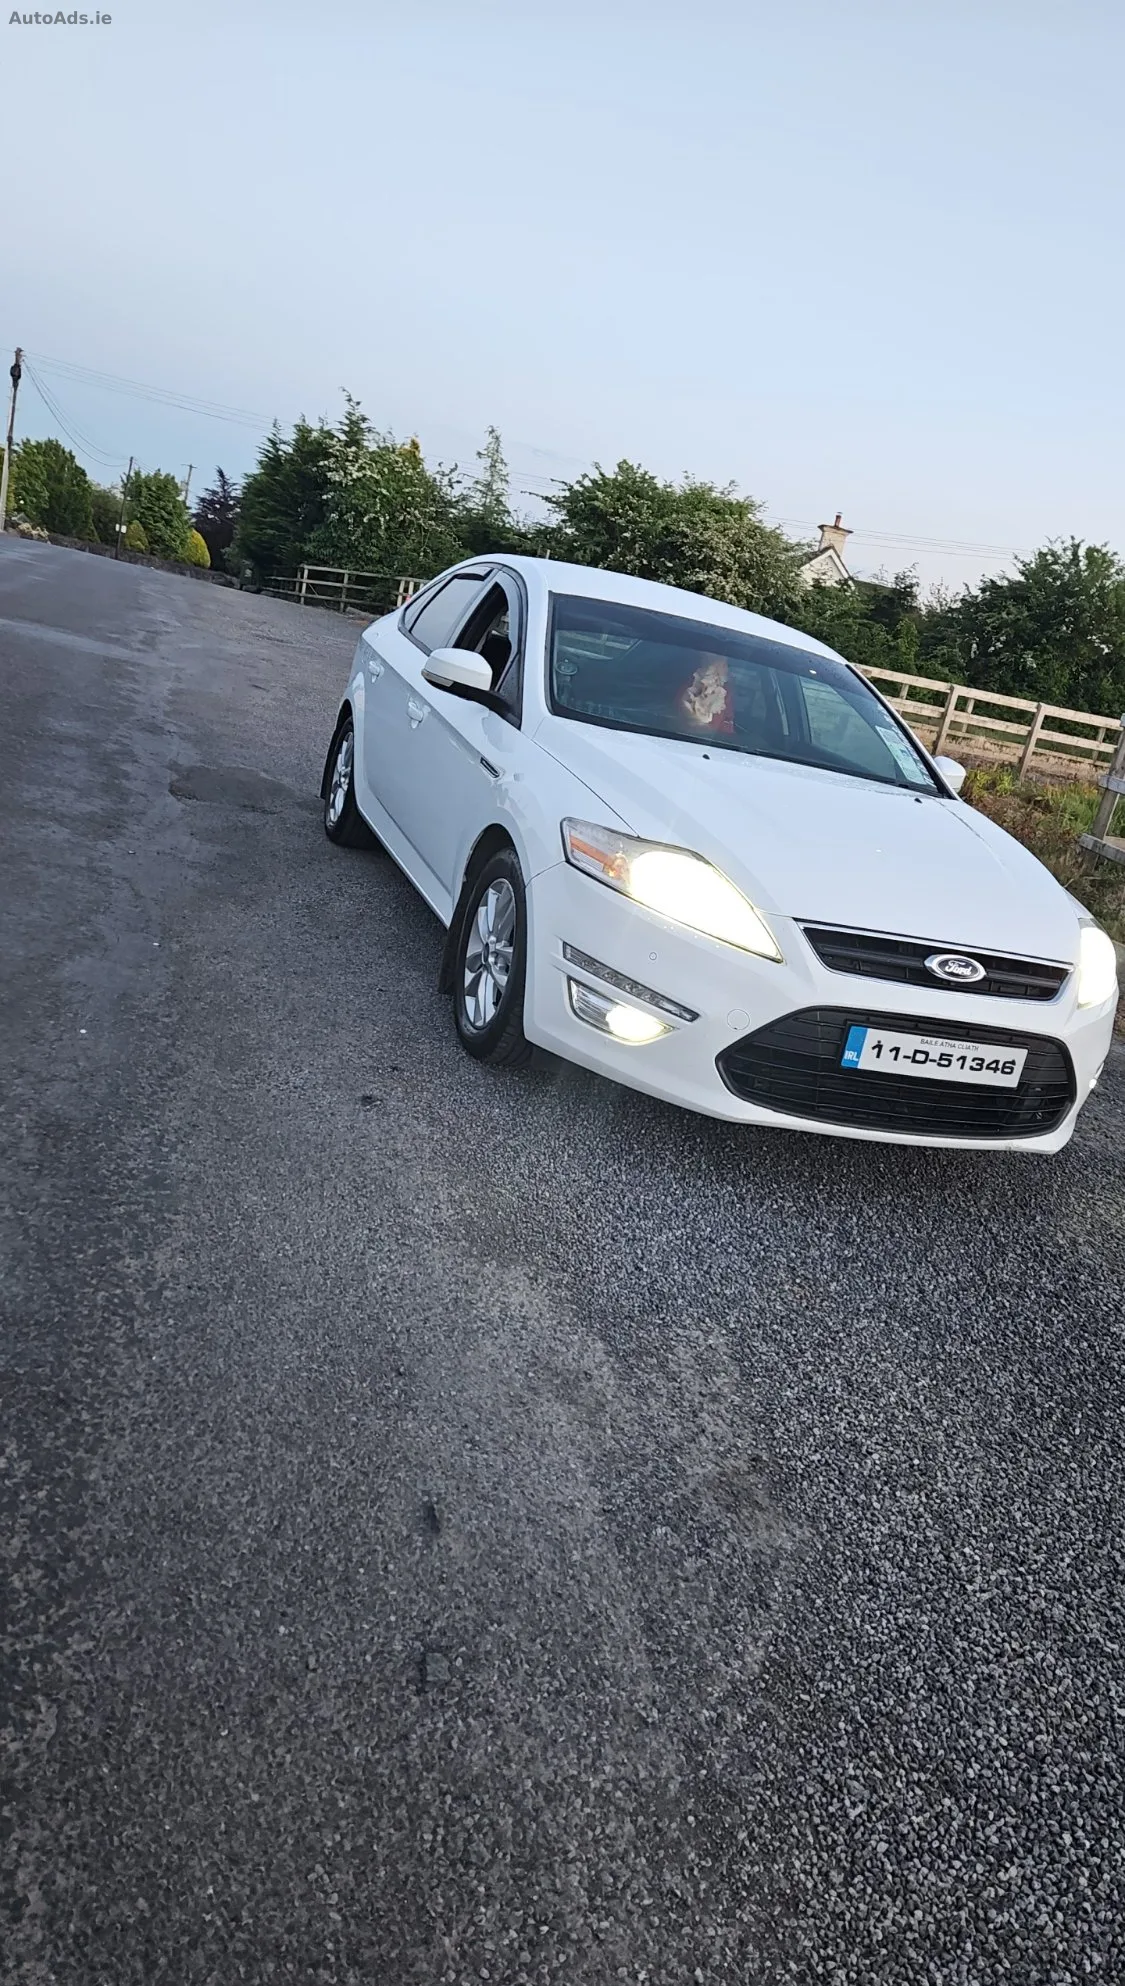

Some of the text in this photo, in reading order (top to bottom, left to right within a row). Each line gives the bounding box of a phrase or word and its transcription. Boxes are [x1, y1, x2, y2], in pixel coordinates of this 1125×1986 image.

[944, 959, 973, 976] Ford
[920, 1038, 939, 1047] BAILE
[957, 1043, 979, 1051] CLIATH
[843, 1050, 859, 1062] IRL
[871, 1042, 1017, 1075] 11-D-51346
